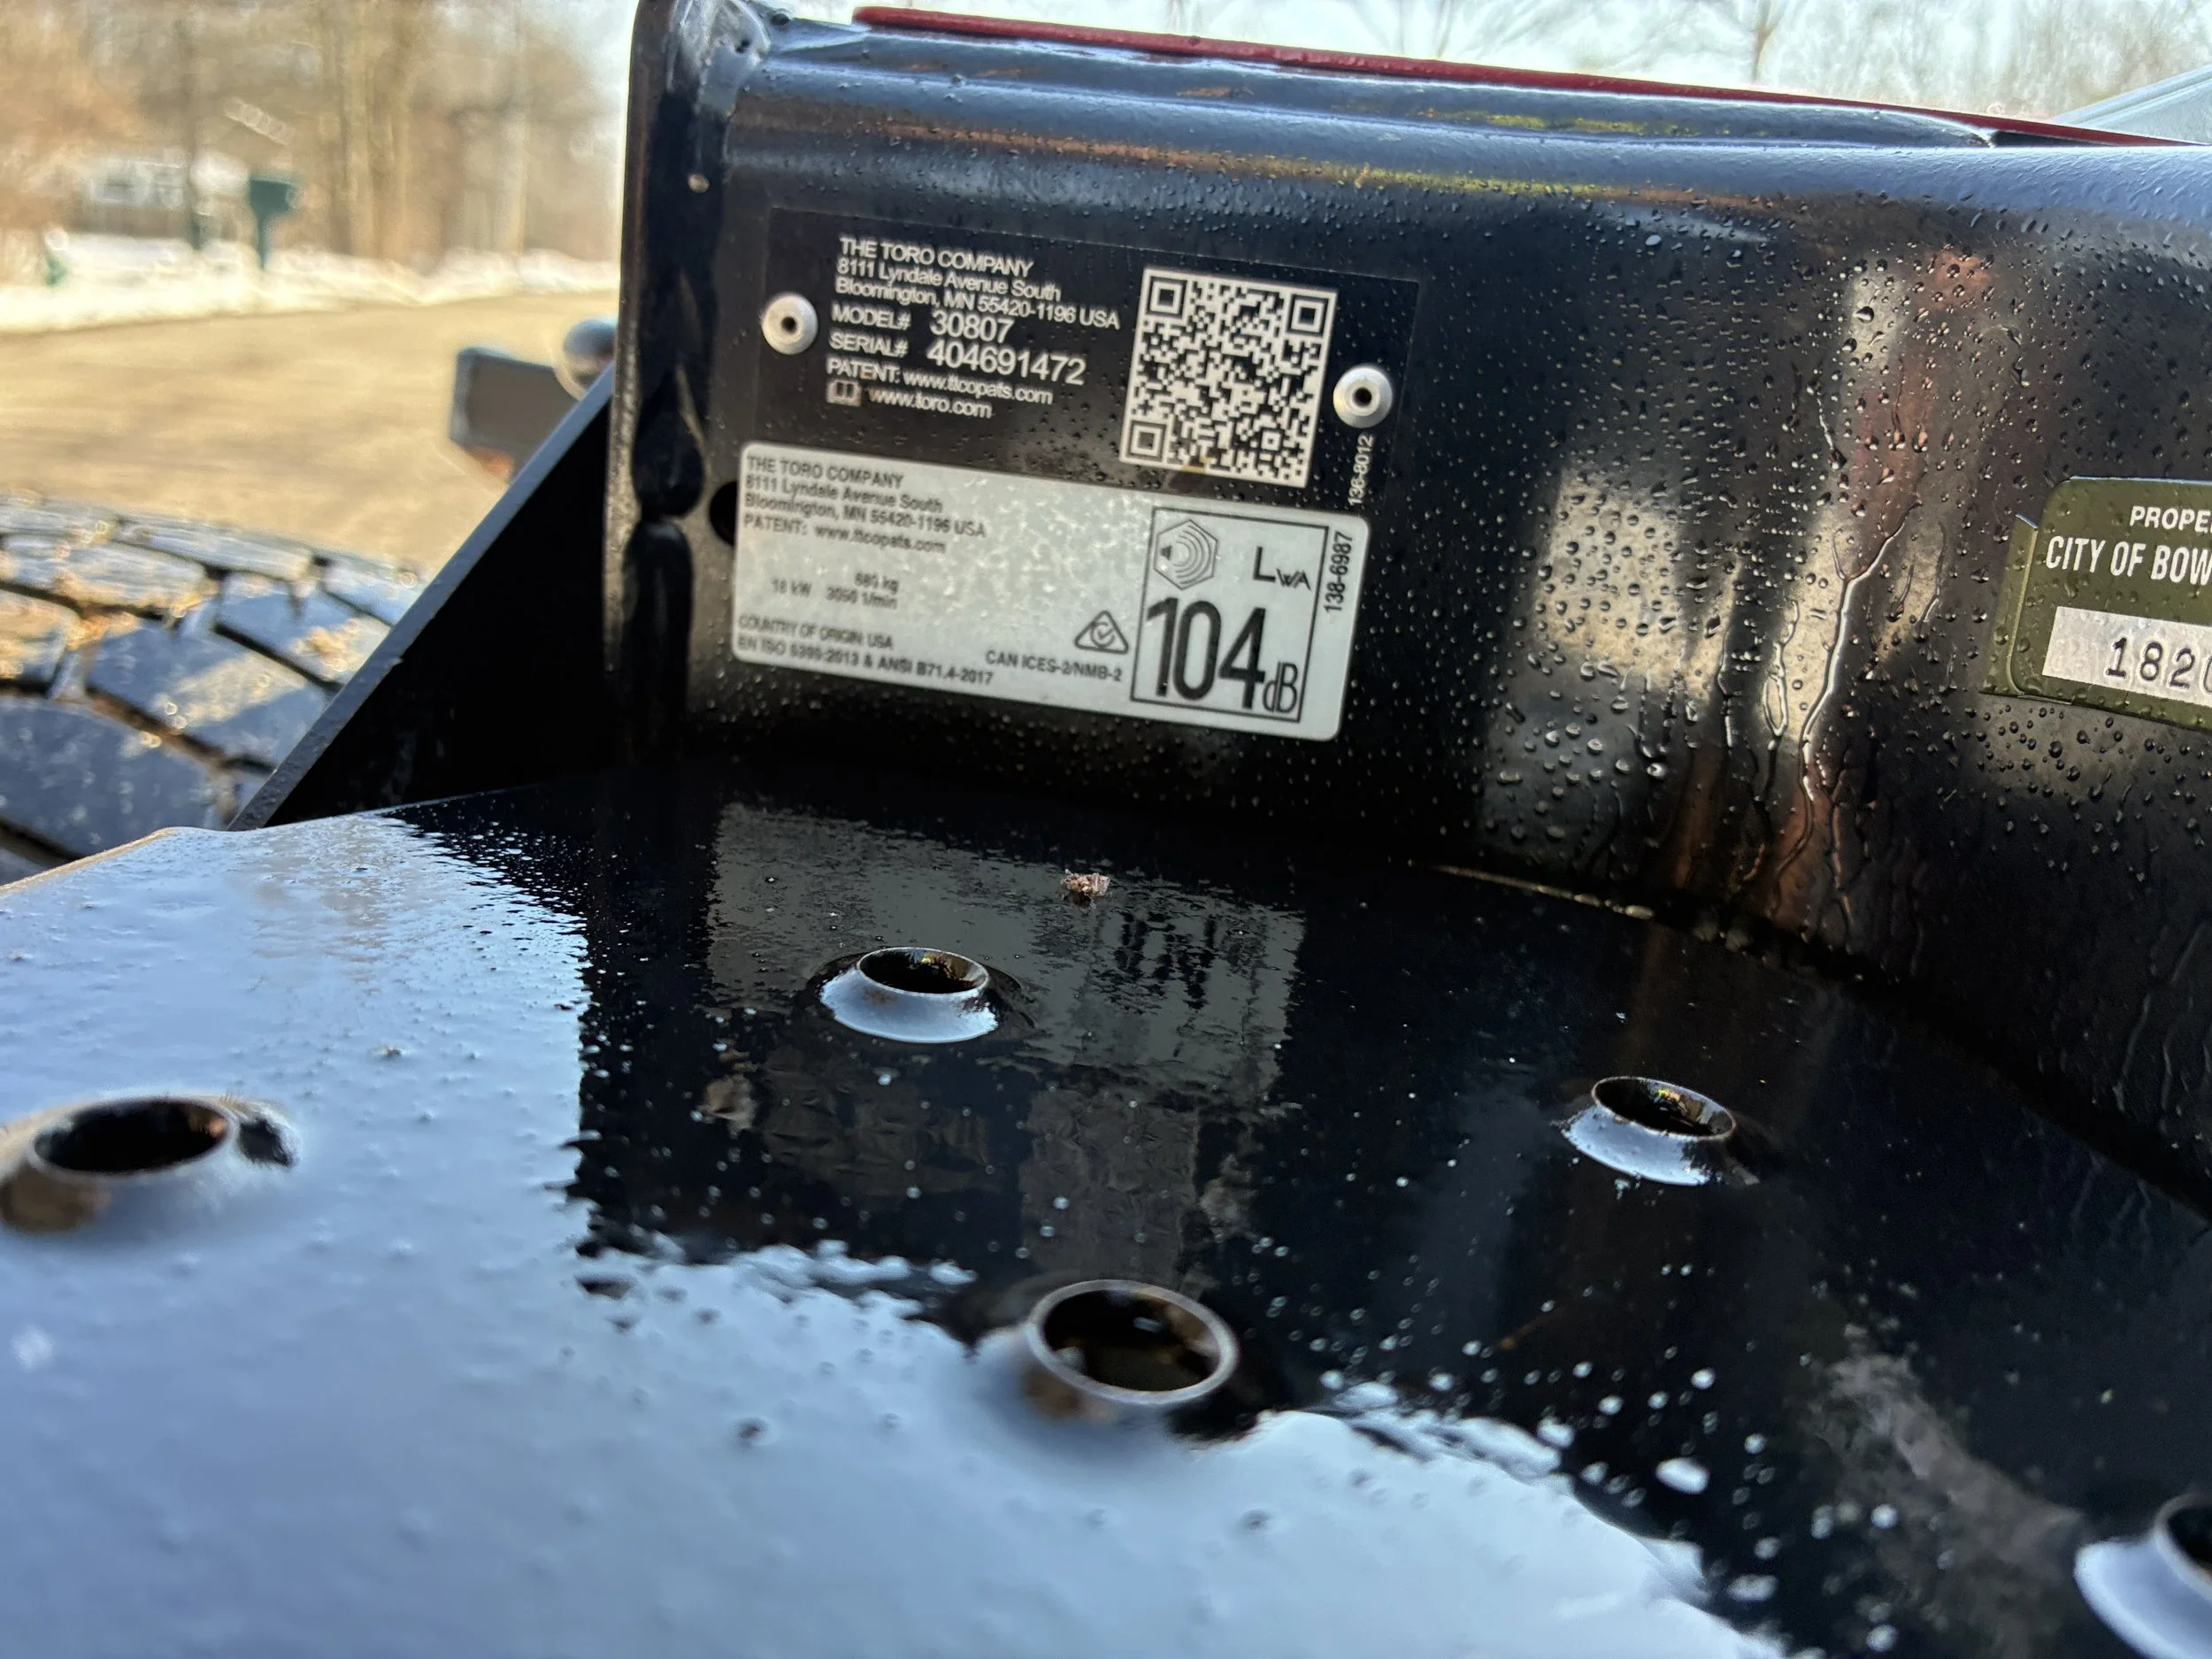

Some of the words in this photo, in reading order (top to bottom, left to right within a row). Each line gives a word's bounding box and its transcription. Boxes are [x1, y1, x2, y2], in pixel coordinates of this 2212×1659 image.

[840, 236, 878, 258] THE
[880, 242, 935, 265] TORO
[938, 249, 1033, 277] COMPANY
[836, 257, 874, 278] 8111
[879, 263, 943, 287] Lyndale
[945, 270, 1008, 293] Avenue
[1011, 279, 1062, 302] South
[831, 303, 911, 331] MODEL#
[929, 310, 1015, 343] 30807
[835, 277, 941, 308] Bloomington,
[942, 288, 974, 309] MN
[977, 295, 1076, 324] 55420-1196
[1079, 307, 1120, 330] USA
[826, 356, 901, 384] PATENT:
[828, 330, 909, 358] SERIAL#
[926, 337, 1087, 387] 404691472
[867, 388, 993, 419] www.toro.com
[747, 455, 776, 472] THE
[780, 459, 822, 479] TORO
[826, 465, 904, 488] COMPANY
[954, 520, 987, 539] USA
[2129, 505, 2212, 534] PROPE
[1325, 531, 1353, 612] 138-6987
[2046, 535, 2107, 573] CITY
[2110, 541, 2147, 578] OF
[985, 649, 1018, 668] CAN
[1146, 596, 1268, 710] 104
